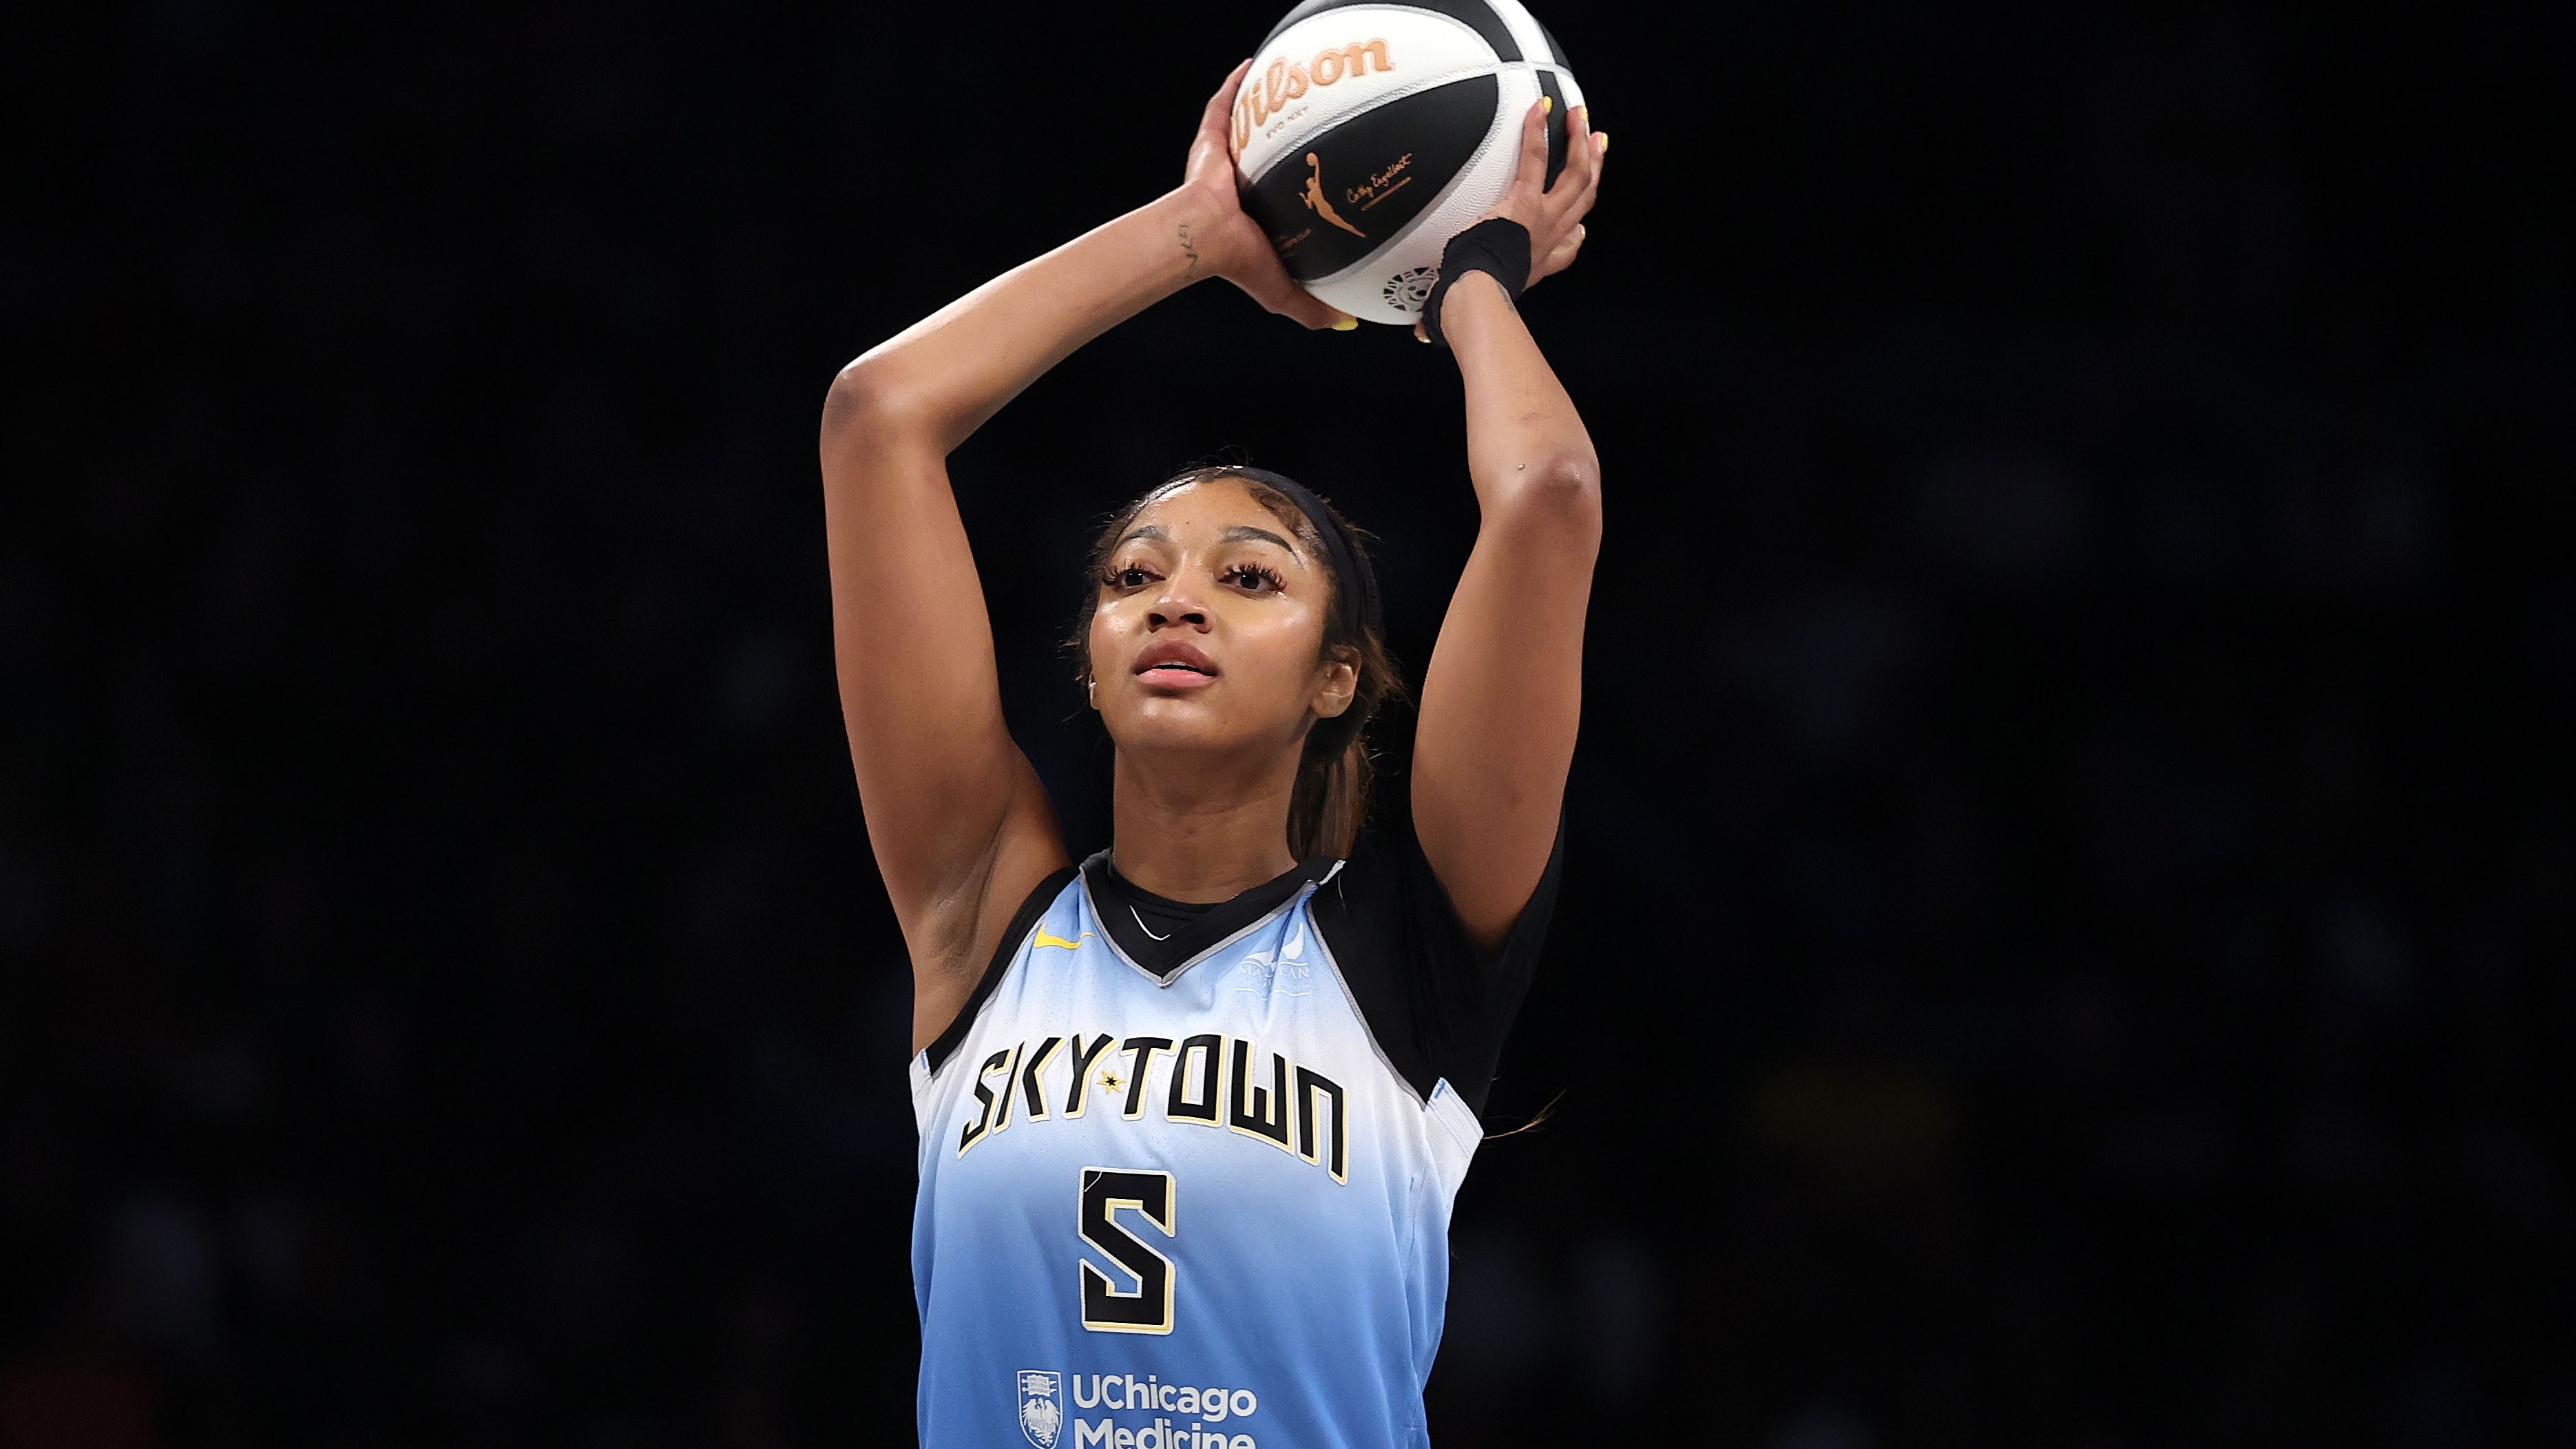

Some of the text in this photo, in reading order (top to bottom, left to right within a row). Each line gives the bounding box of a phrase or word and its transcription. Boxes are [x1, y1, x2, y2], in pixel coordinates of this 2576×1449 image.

[957, 1032, 1349, 1186] SKYTOWN
[1078, 1166, 1176, 1335] 5
[1073, 1373, 1257, 1422] UChicago
[1074, 1417, 1256, 1449] Medicine
